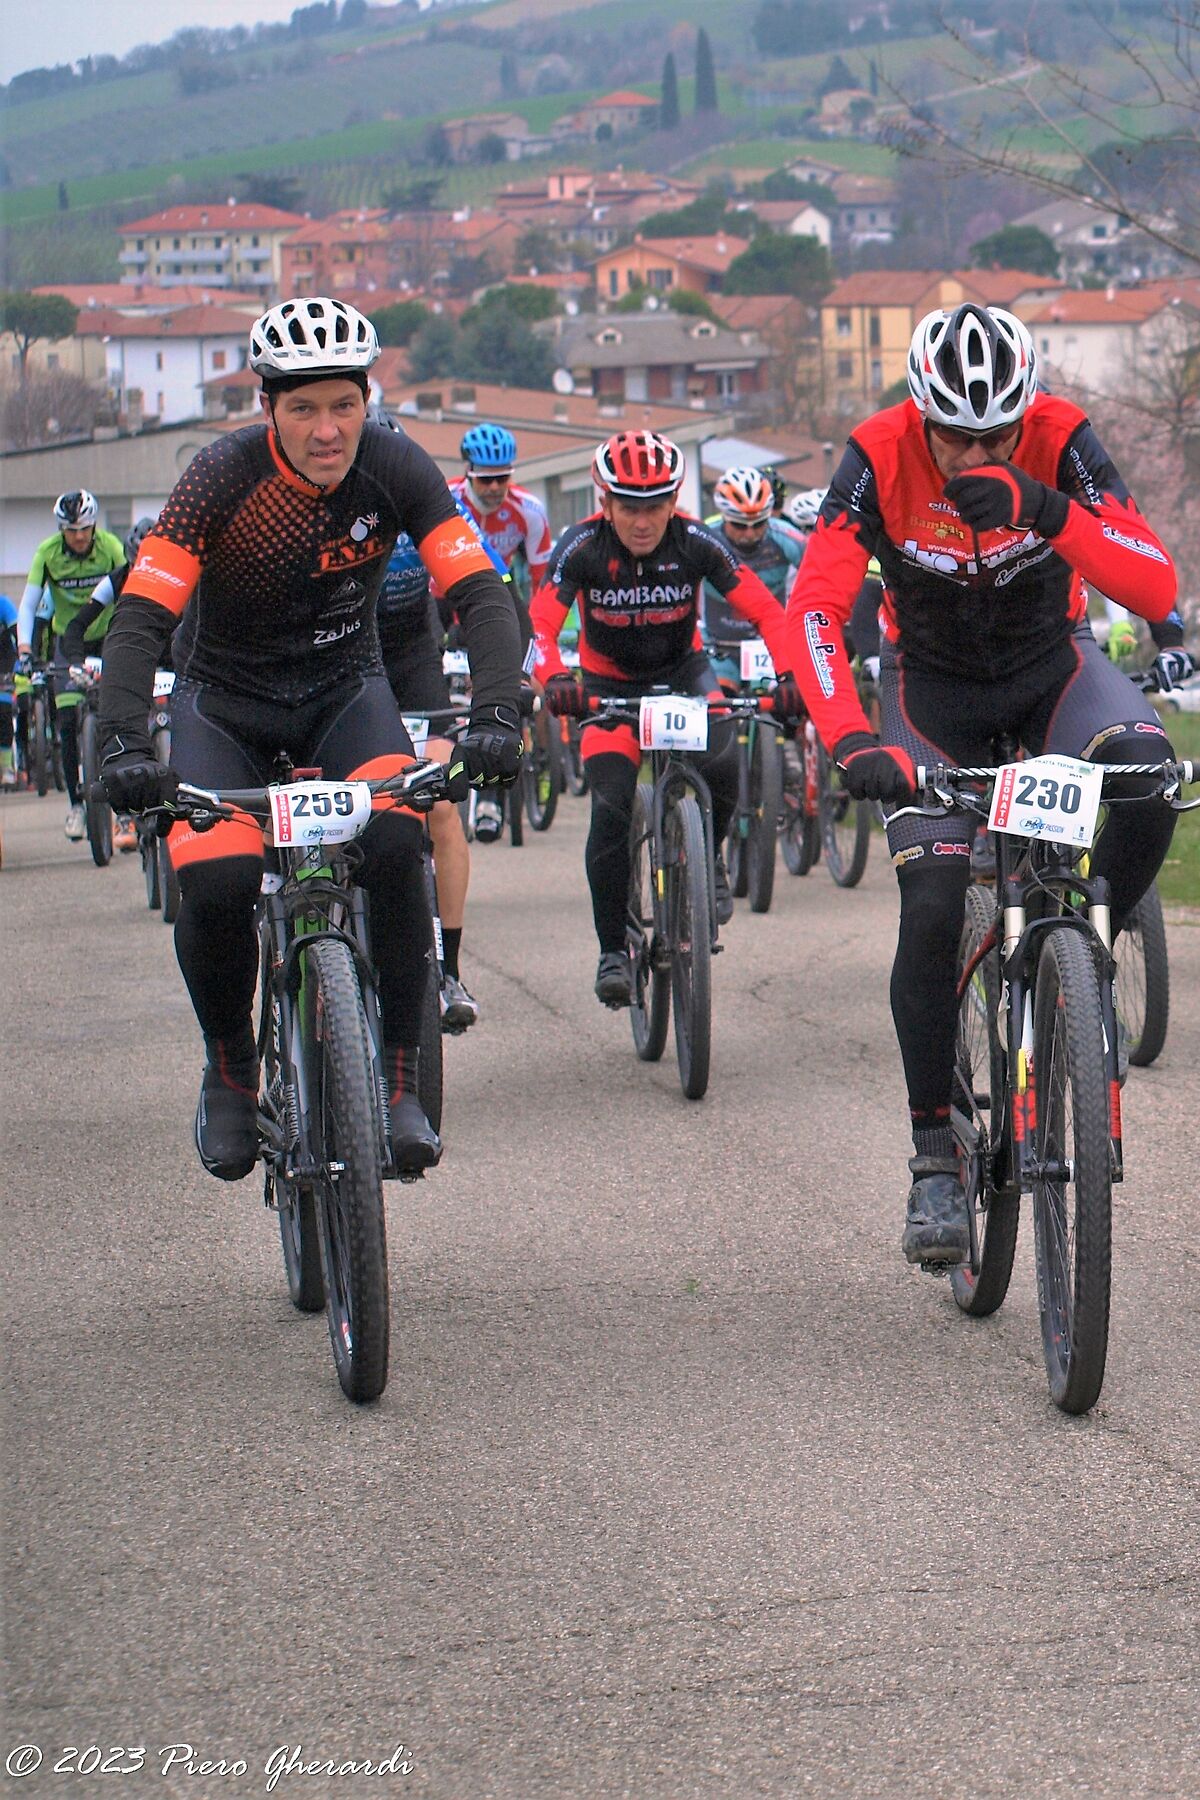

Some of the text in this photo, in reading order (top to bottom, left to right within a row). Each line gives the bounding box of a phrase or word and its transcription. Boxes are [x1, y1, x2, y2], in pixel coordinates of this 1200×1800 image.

[134, 555, 187, 588] Sermar
[589, 583, 693, 607] BAMBANA
[664, 712, 686, 731] 10
[291, 791, 355, 818] 259
[996, 768, 1015, 827] ABBONATO
[1015, 775, 1082, 815] 230
